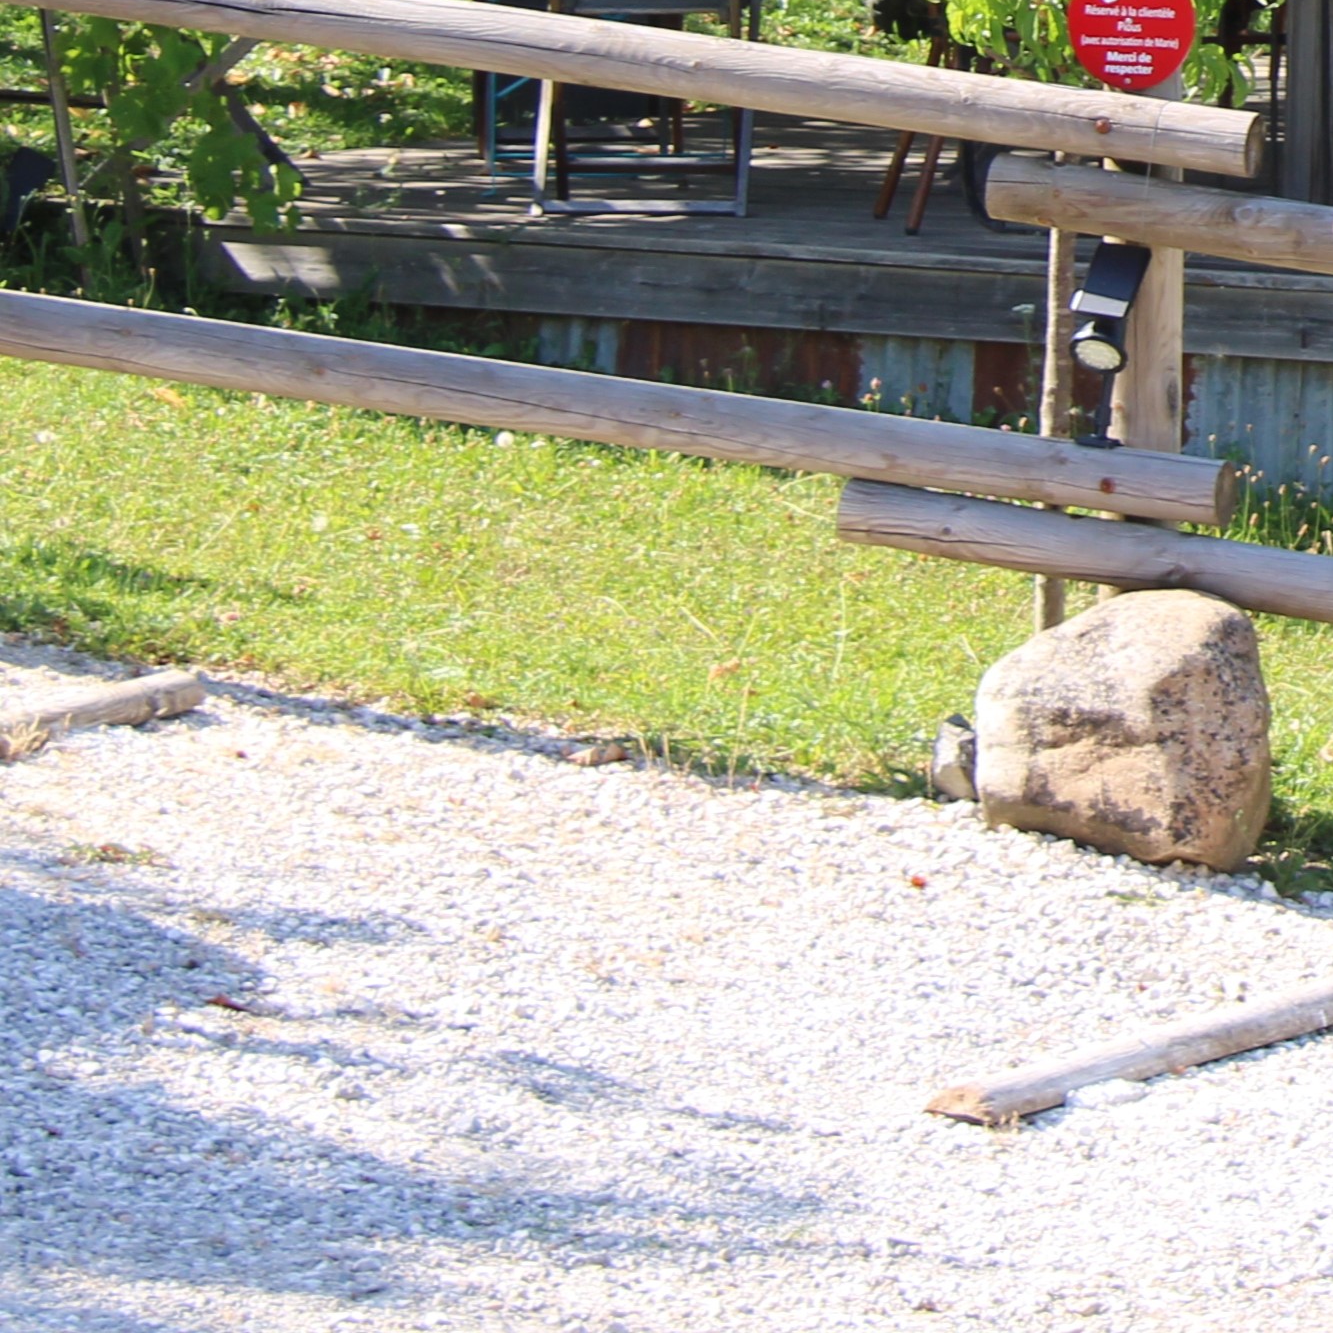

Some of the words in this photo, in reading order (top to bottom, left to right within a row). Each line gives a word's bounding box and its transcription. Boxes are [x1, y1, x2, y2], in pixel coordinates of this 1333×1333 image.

[1084, 4, 1120, 16] Réservé
[1121, 5, 1127, 17] à
[1128, 6, 1137, 17] la
[1138, 7, 1176, 19] clientèle
[1081, 34, 1101, 46] (avec
[1101, 36, 1144, 47] autorisation
[1144, 37, 1154, 48] de
[1154, 37, 1180, 50] Marie)
[1106, 51, 1137, 63] Merci
[1138, 52, 1153, 64] de
[1104, 64, 1154, 75] respecter
